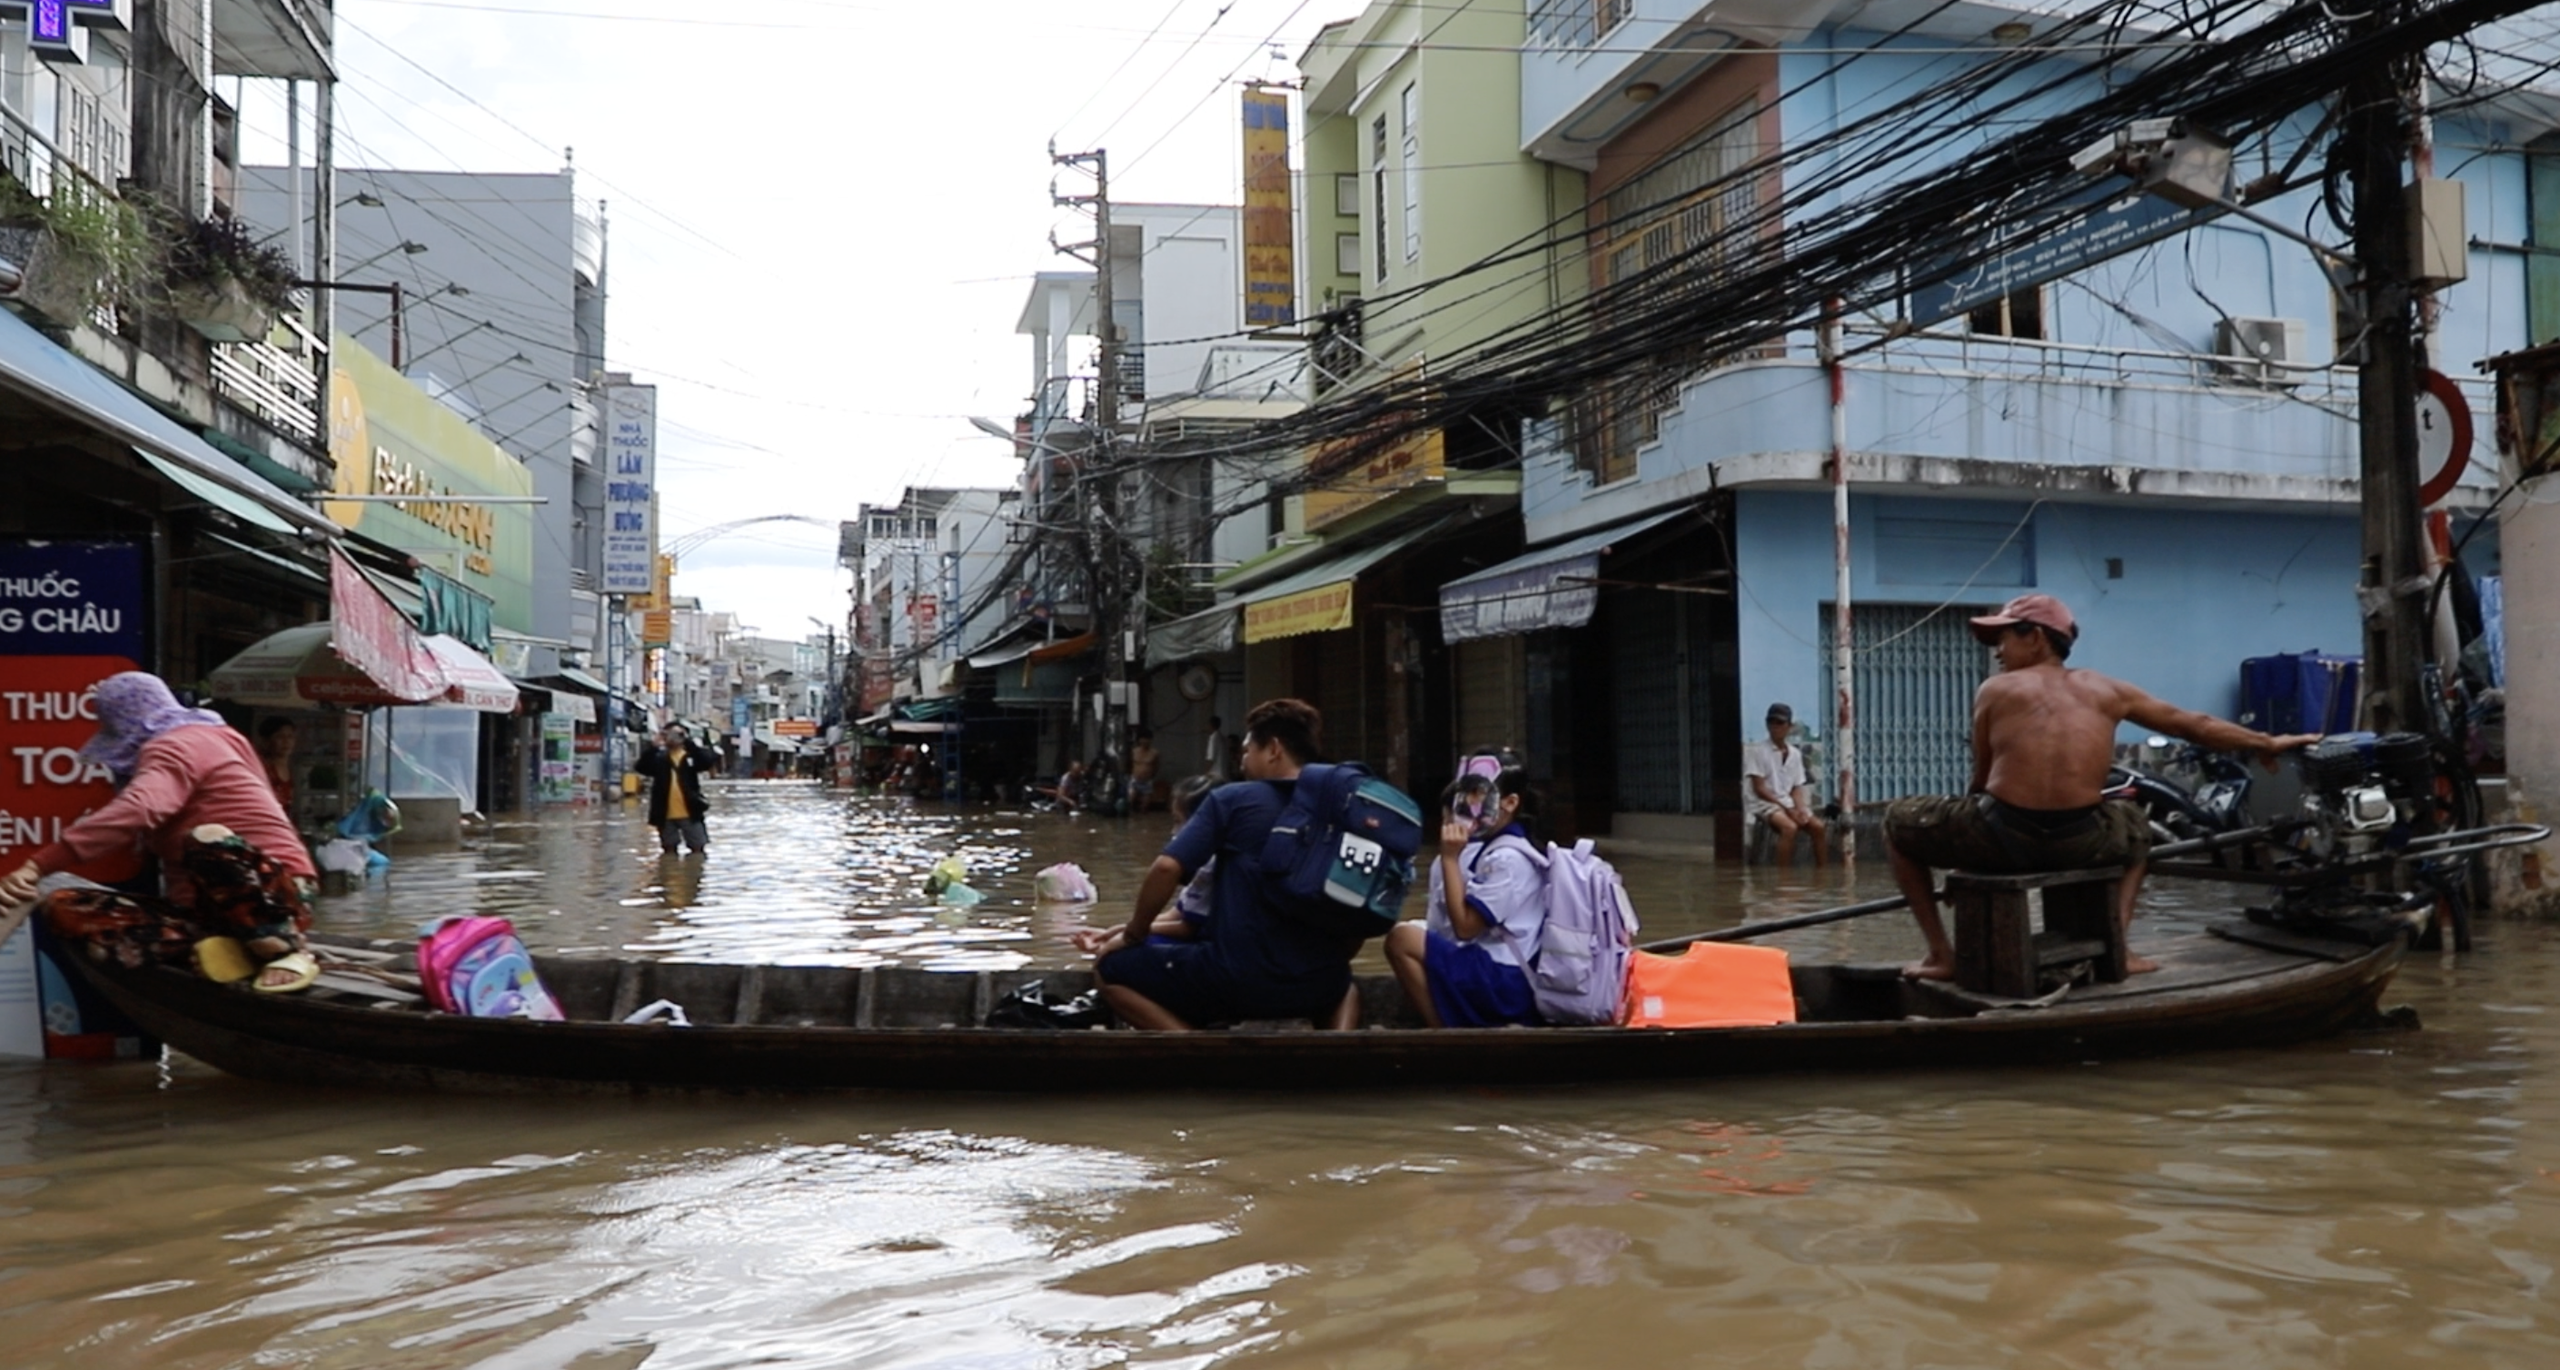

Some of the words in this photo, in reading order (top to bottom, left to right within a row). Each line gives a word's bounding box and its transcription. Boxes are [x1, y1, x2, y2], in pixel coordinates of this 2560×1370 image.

[618, 422, 642, 434] NHÀ
[612, 435, 649, 447] THUỐC
[31, 601, 122, 633] CHÂU
[3, 682, 103, 721] THUỐ
